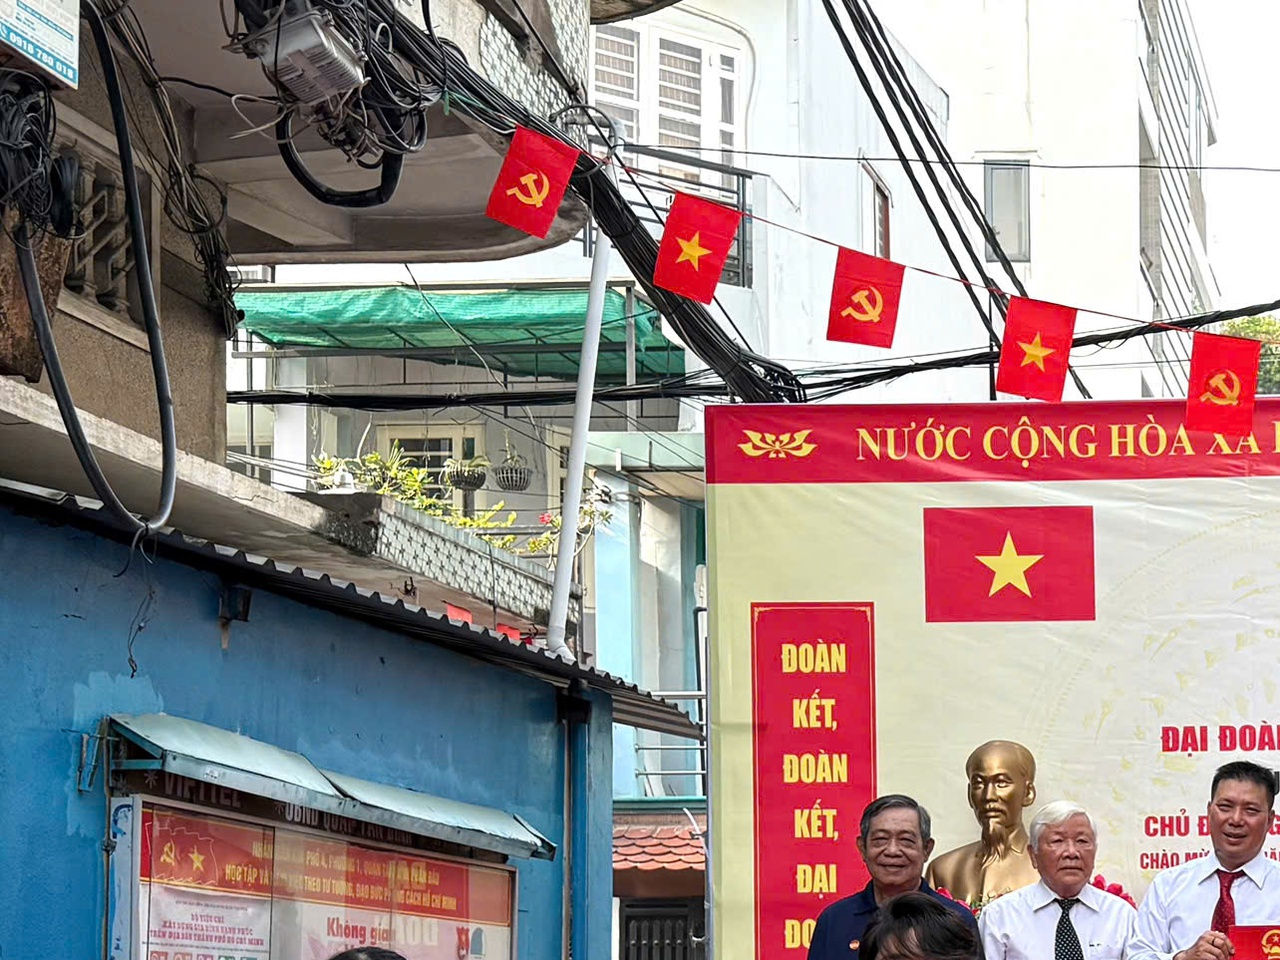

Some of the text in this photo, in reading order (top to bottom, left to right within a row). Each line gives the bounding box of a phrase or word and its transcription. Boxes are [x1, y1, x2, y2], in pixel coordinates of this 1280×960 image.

[856, 417, 970, 461] NƯỚC
[982, 416, 1097, 467] CỘNG
[1108, 414, 1195, 457] HÒA
[782, 639, 847, 673] ĐOÀN
[793, 689, 838, 731] KẾT,
[1161, 725, 1209, 757] ĐẠI
[783, 749, 848, 784] ĐOÀN
[794, 799, 839, 841] KẾT,
[1144, 808, 1211, 837] CHỦ Đ
[1140, 849, 1180, 870] CHÀO
[797, 863, 837, 899] ĐẠI
[326, 917, 367, 944] Không
[785, 918, 817, 949] ĐO
